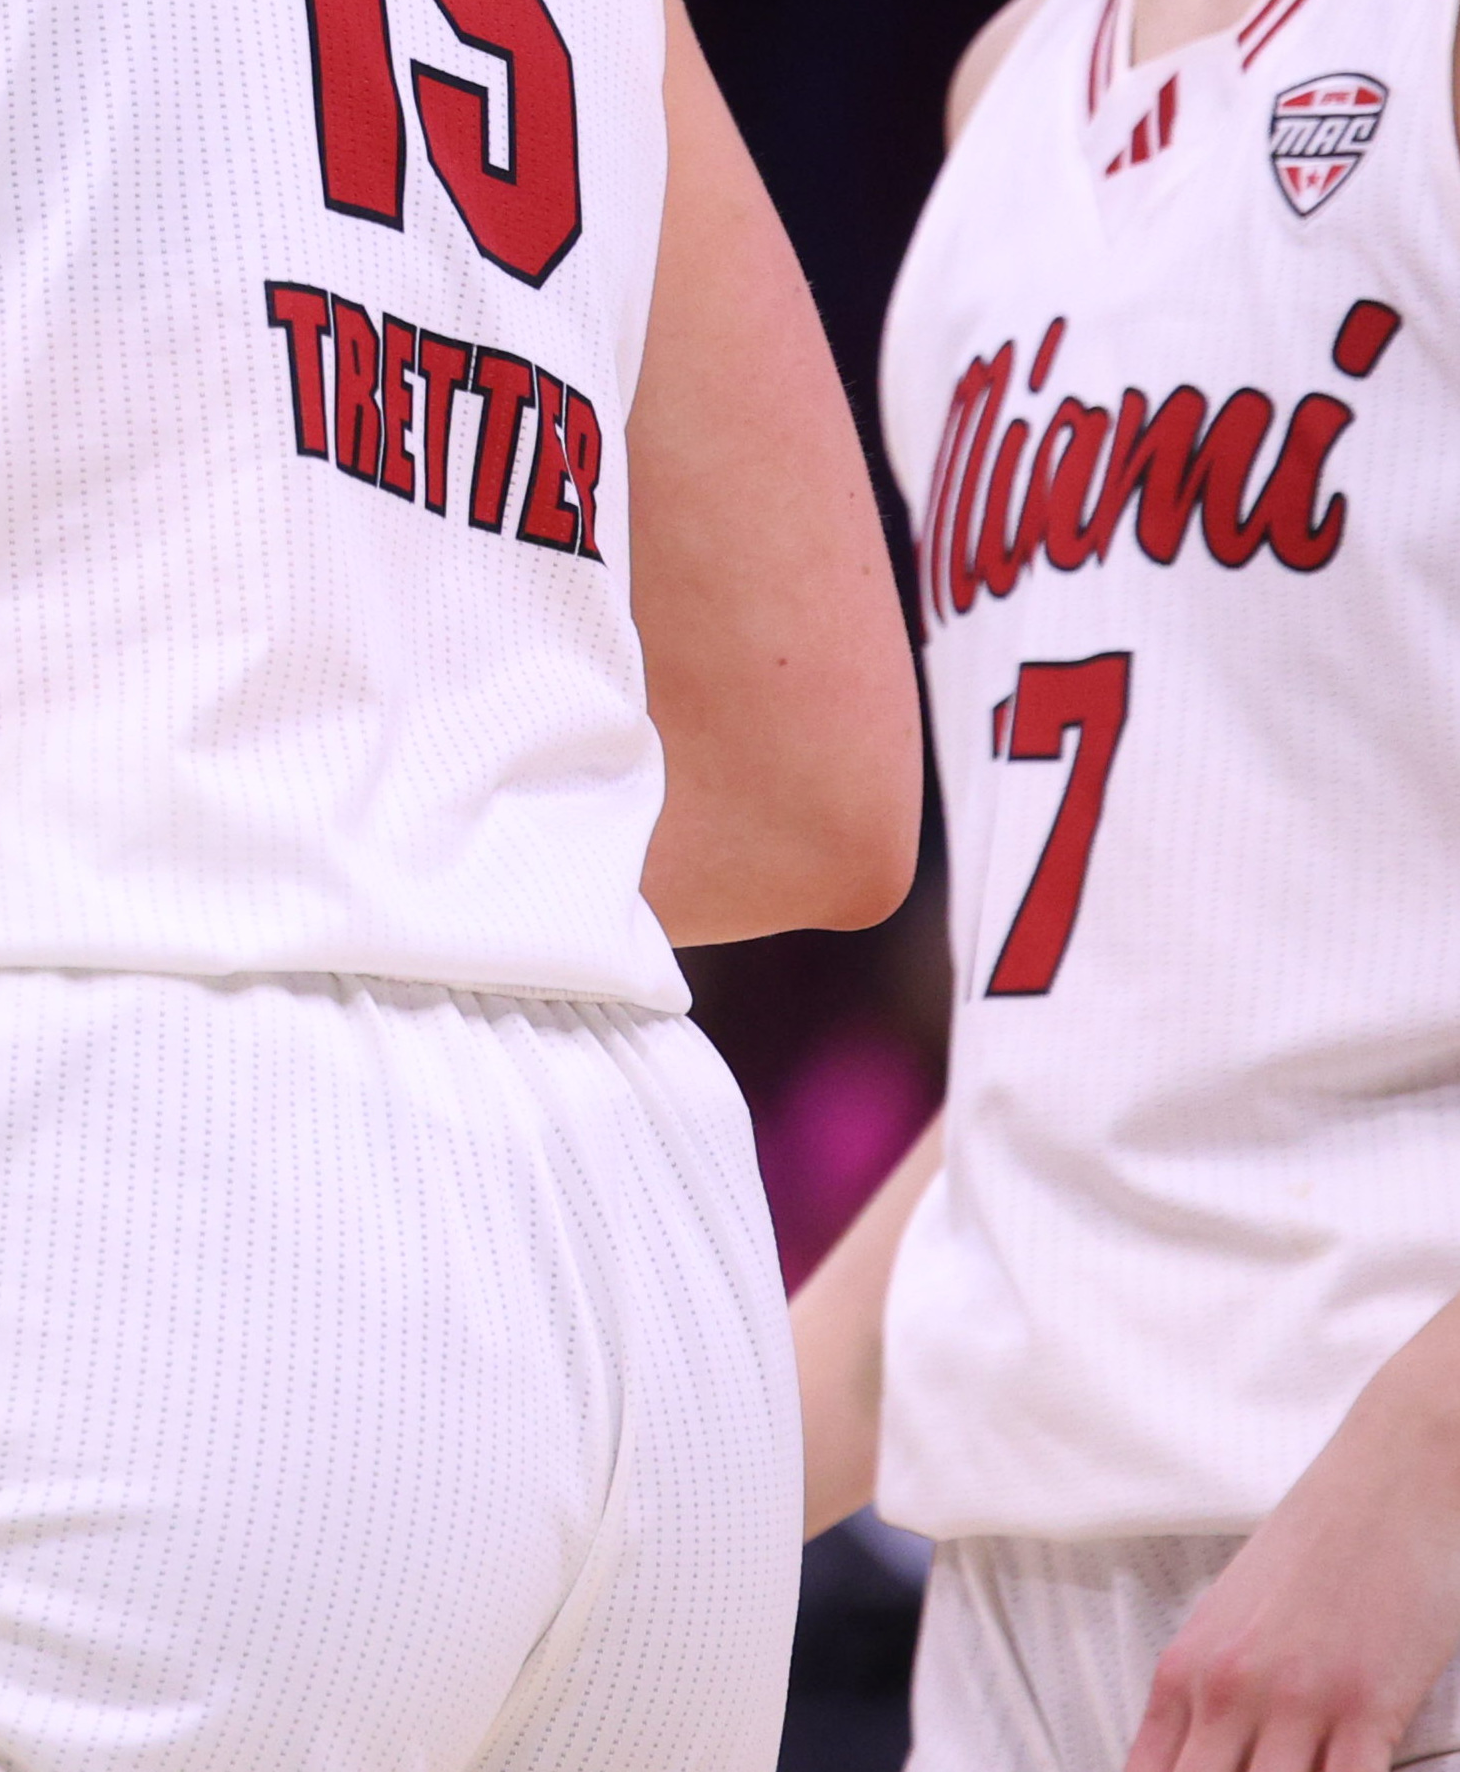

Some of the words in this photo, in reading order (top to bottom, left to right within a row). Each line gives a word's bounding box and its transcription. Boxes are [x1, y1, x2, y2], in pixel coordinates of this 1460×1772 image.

[1270, 114, 1379, 157] MAC
[263, 278, 609, 568] TRETTER
[917, 299, 1403, 646] Miami
[985, 650, 1133, 997] 7
